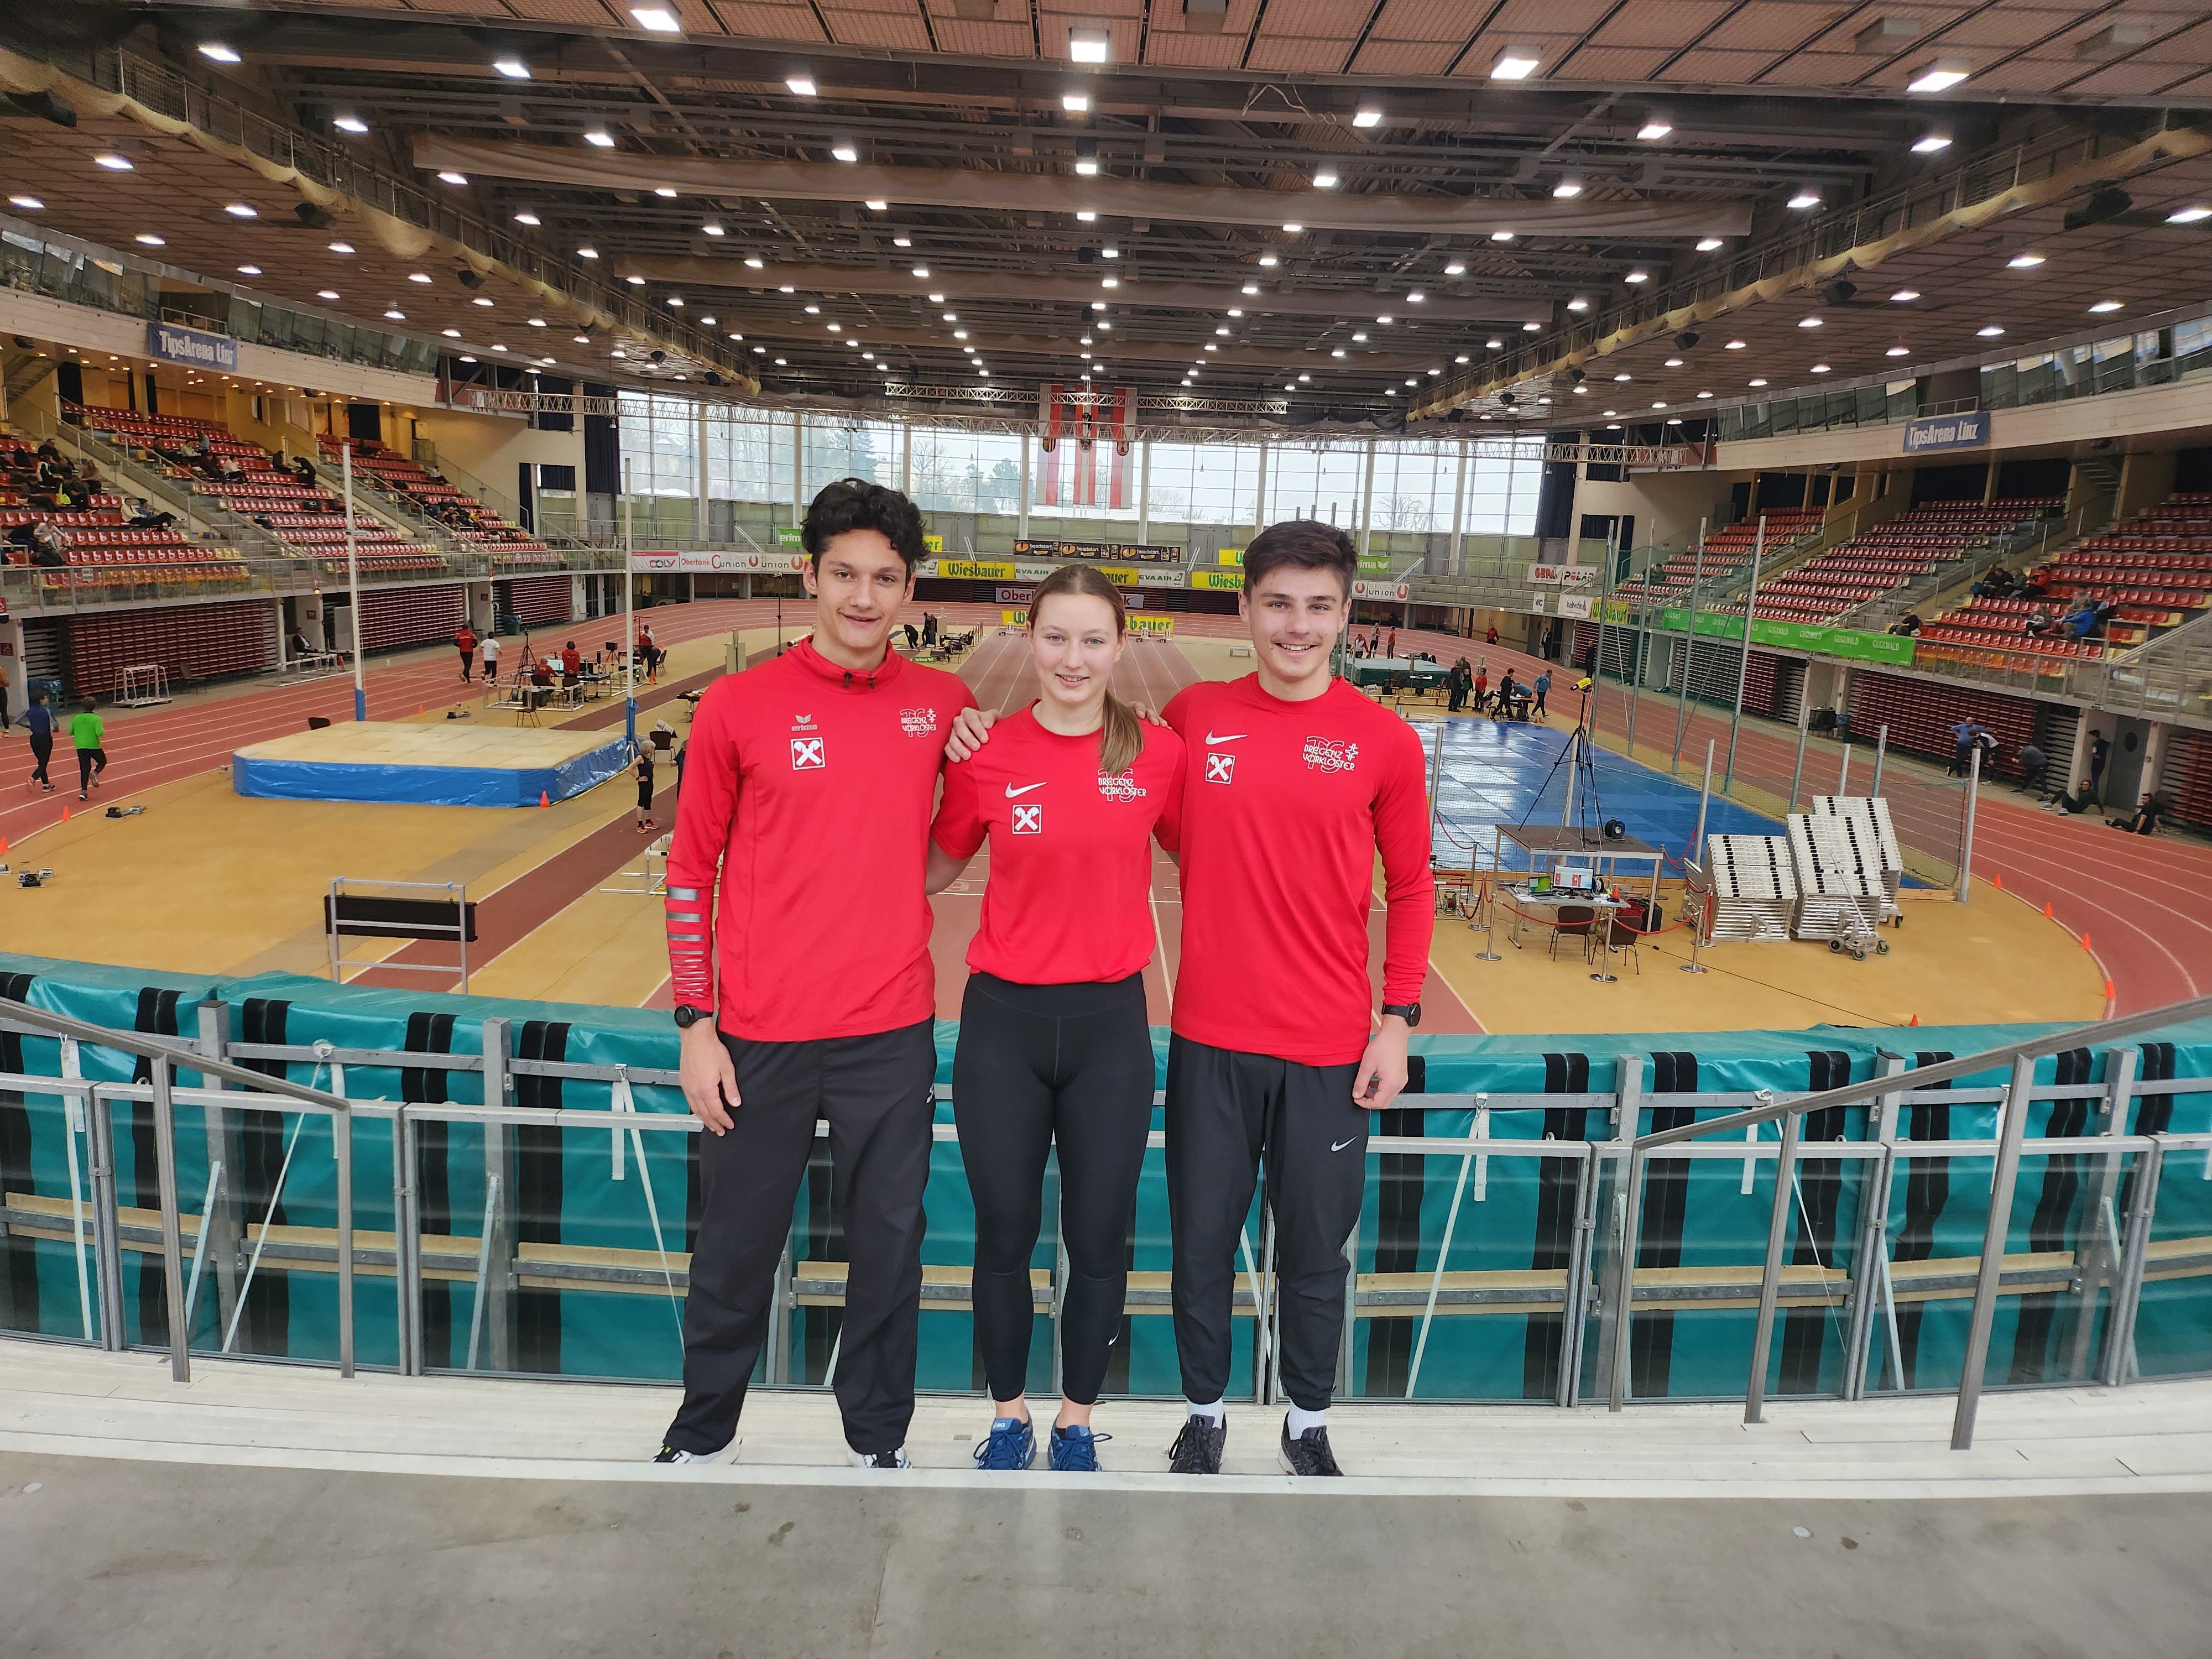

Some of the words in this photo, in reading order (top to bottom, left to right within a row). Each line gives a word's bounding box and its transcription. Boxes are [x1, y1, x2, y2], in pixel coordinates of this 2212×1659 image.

[159, 330, 214, 361] TipsArena
[1909, 424, 1956, 450] TipsArena
[1957, 420, 1979, 441] Linz
[780, 533, 802, 542] erim
[948, 562, 1005, 578] Wiesbauer
[1535, 567, 1556, 579] GEPA
[1567, 600, 1582, 609] helvetia
[1303, 744, 1343, 759] BREGENZ
[1302, 753, 1355, 771] VORKLOSTER
[1098, 777, 1134, 786] BREGENZ
[1098, 786, 1146, 797] VORKLOSTER
